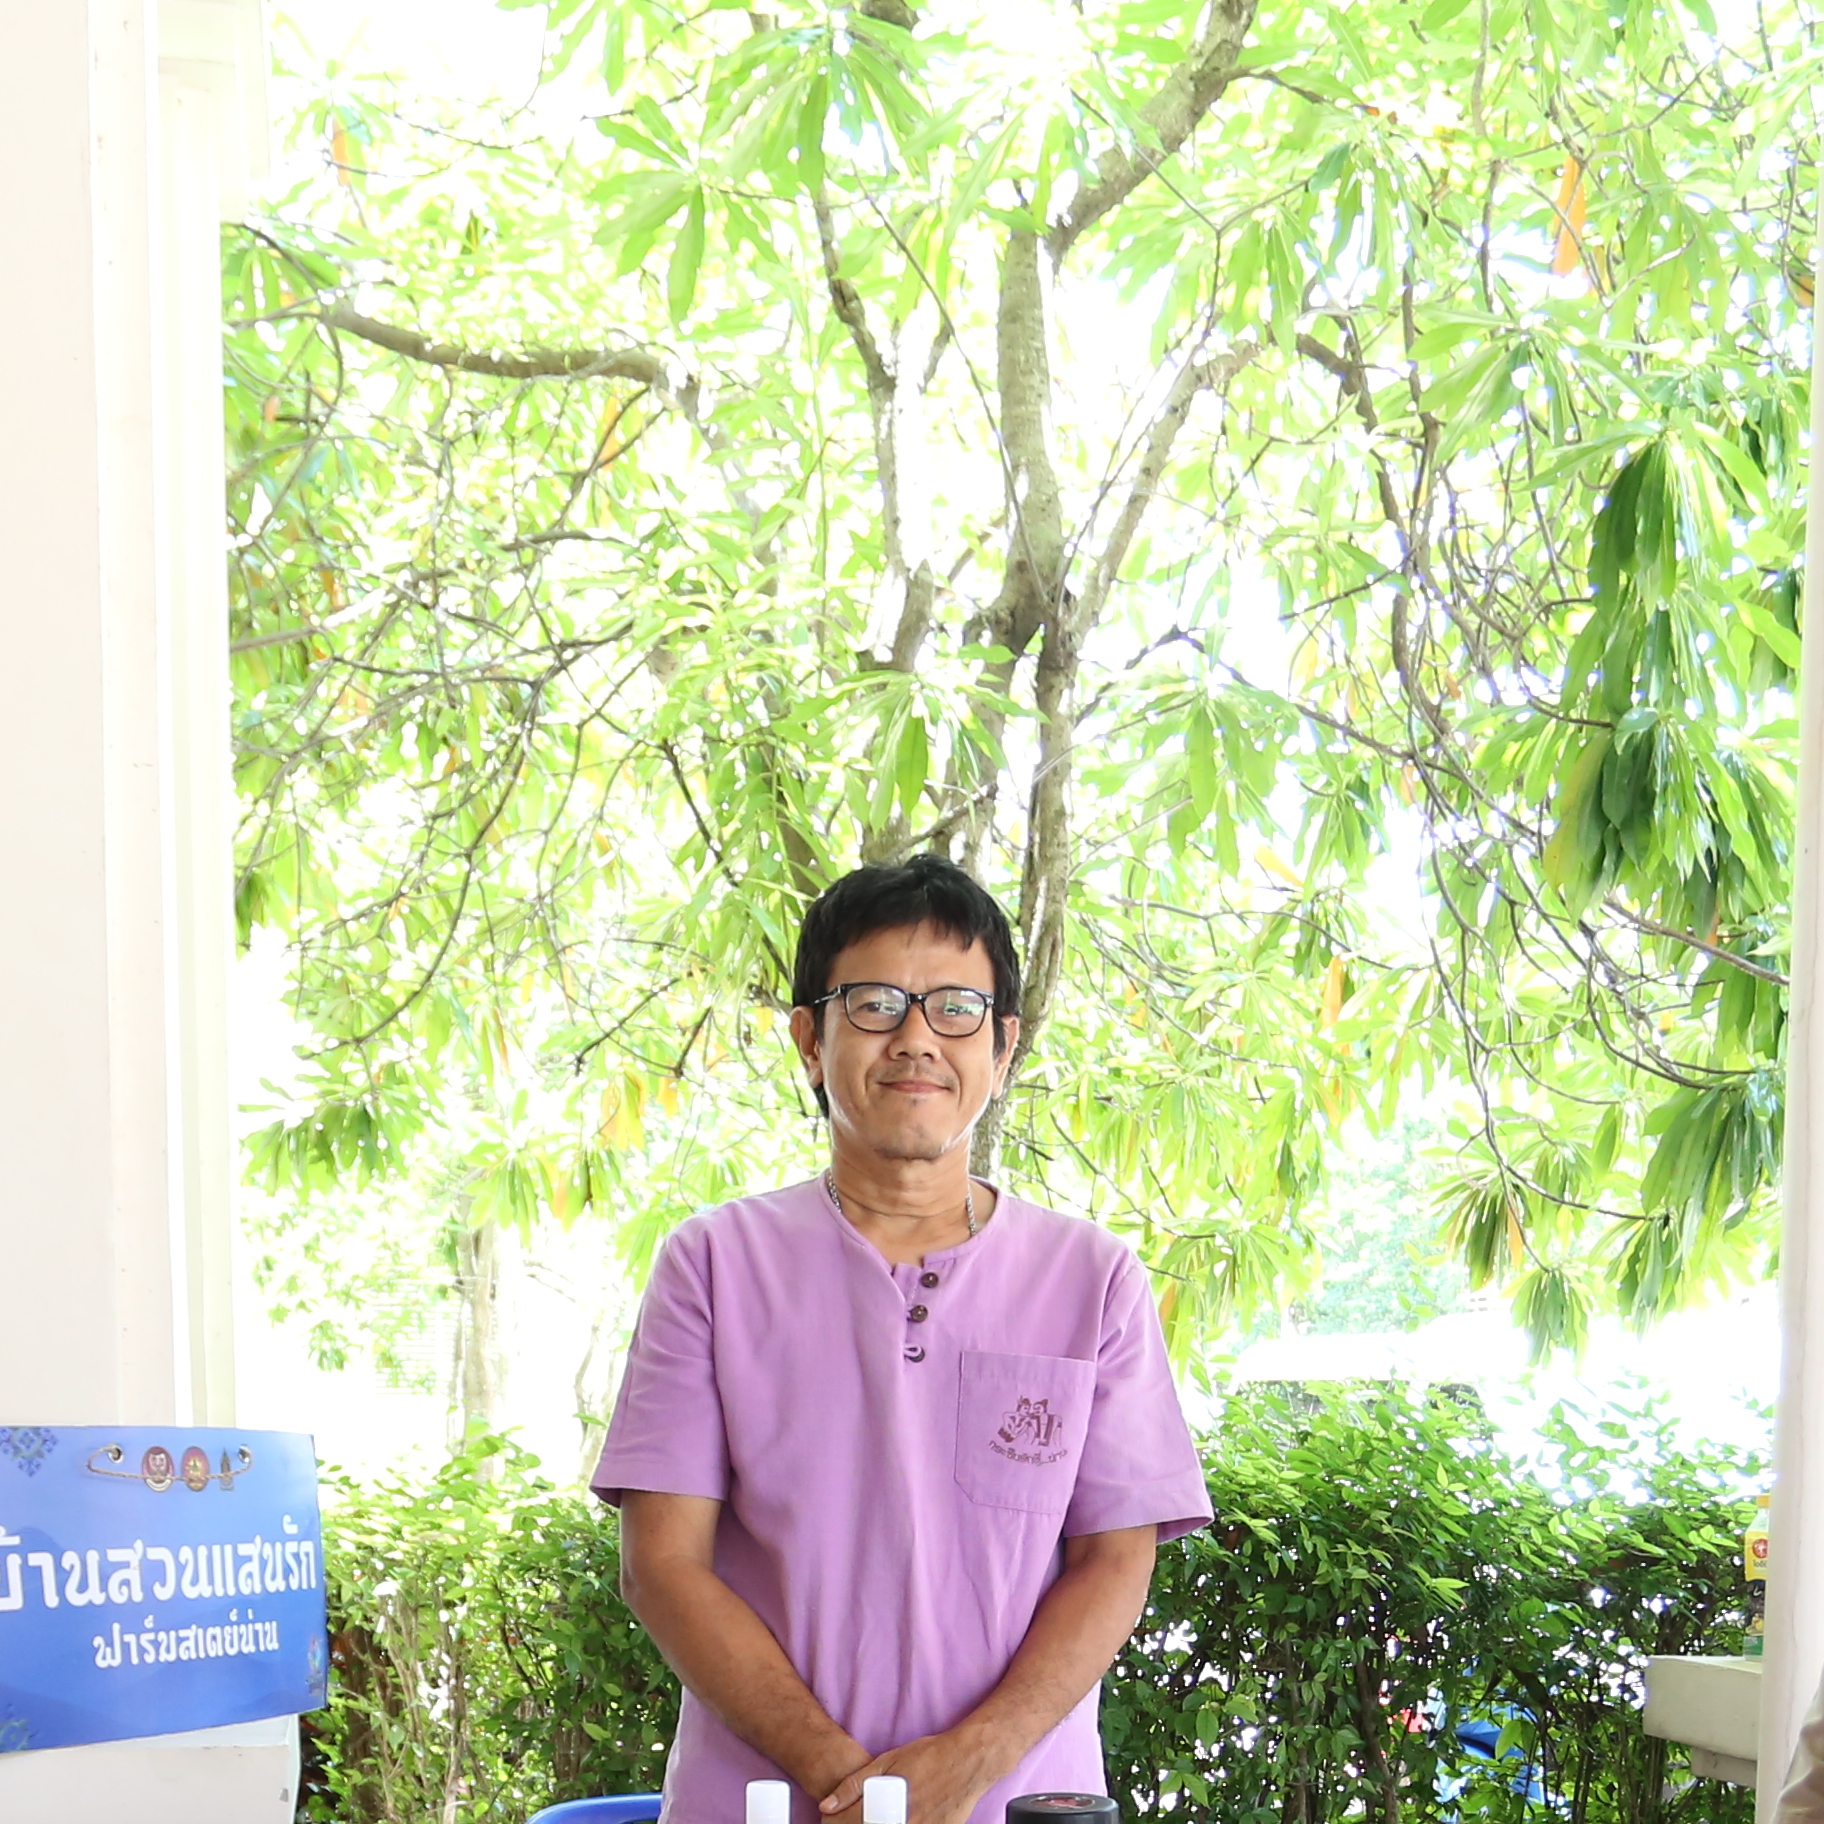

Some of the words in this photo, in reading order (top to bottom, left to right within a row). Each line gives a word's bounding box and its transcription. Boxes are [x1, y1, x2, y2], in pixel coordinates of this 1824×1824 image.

[92, 1607, 279, 1669] ฟาร์มสเตย์น่าน
